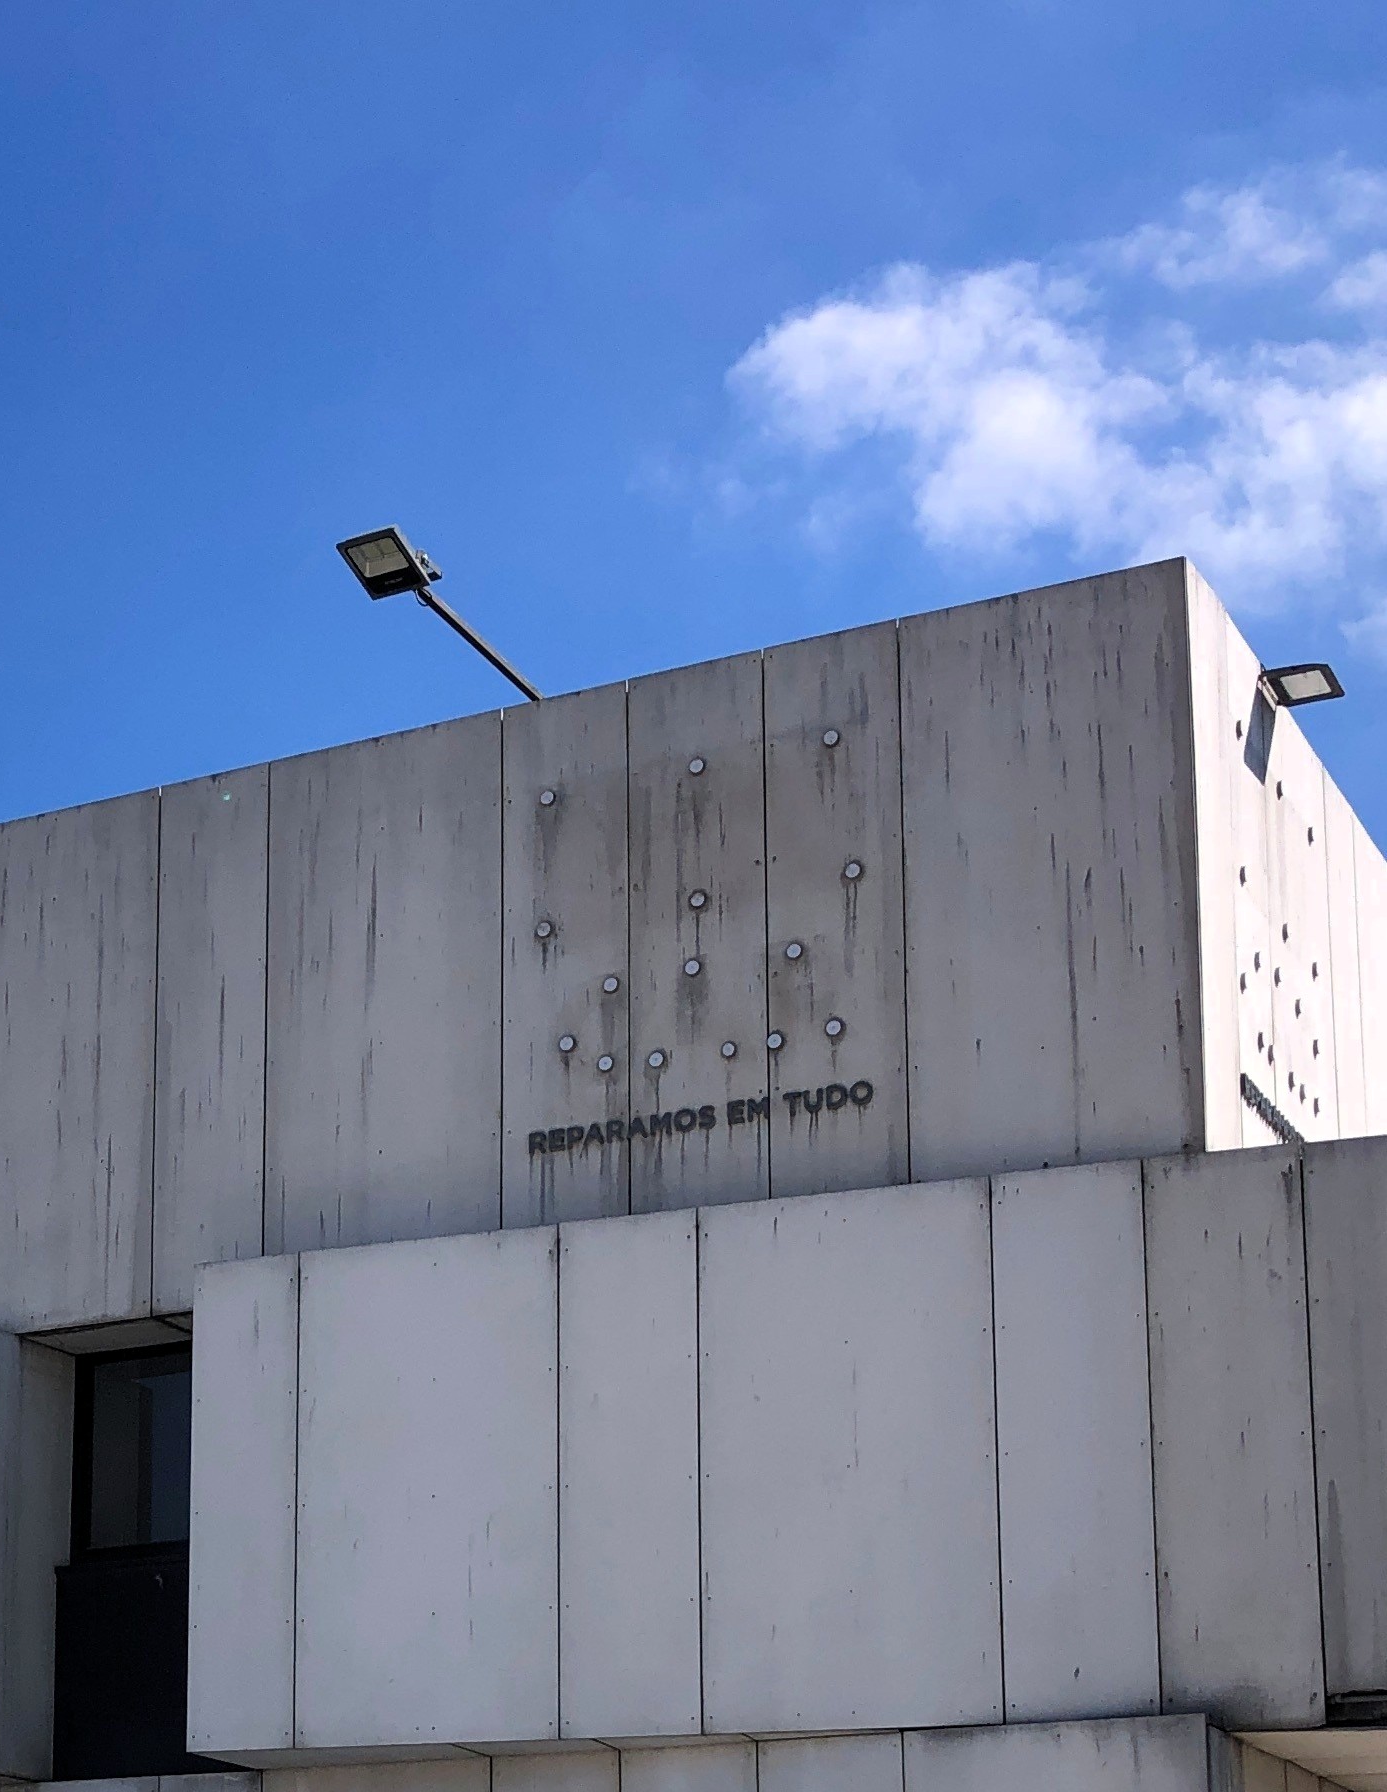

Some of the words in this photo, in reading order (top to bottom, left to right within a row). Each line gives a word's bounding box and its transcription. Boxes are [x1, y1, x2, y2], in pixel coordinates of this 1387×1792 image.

[527, 1104, 717, 1156] REPARAMOS
[726, 1096, 770, 1127] EM
[782, 1079, 875, 1118] TUDO
